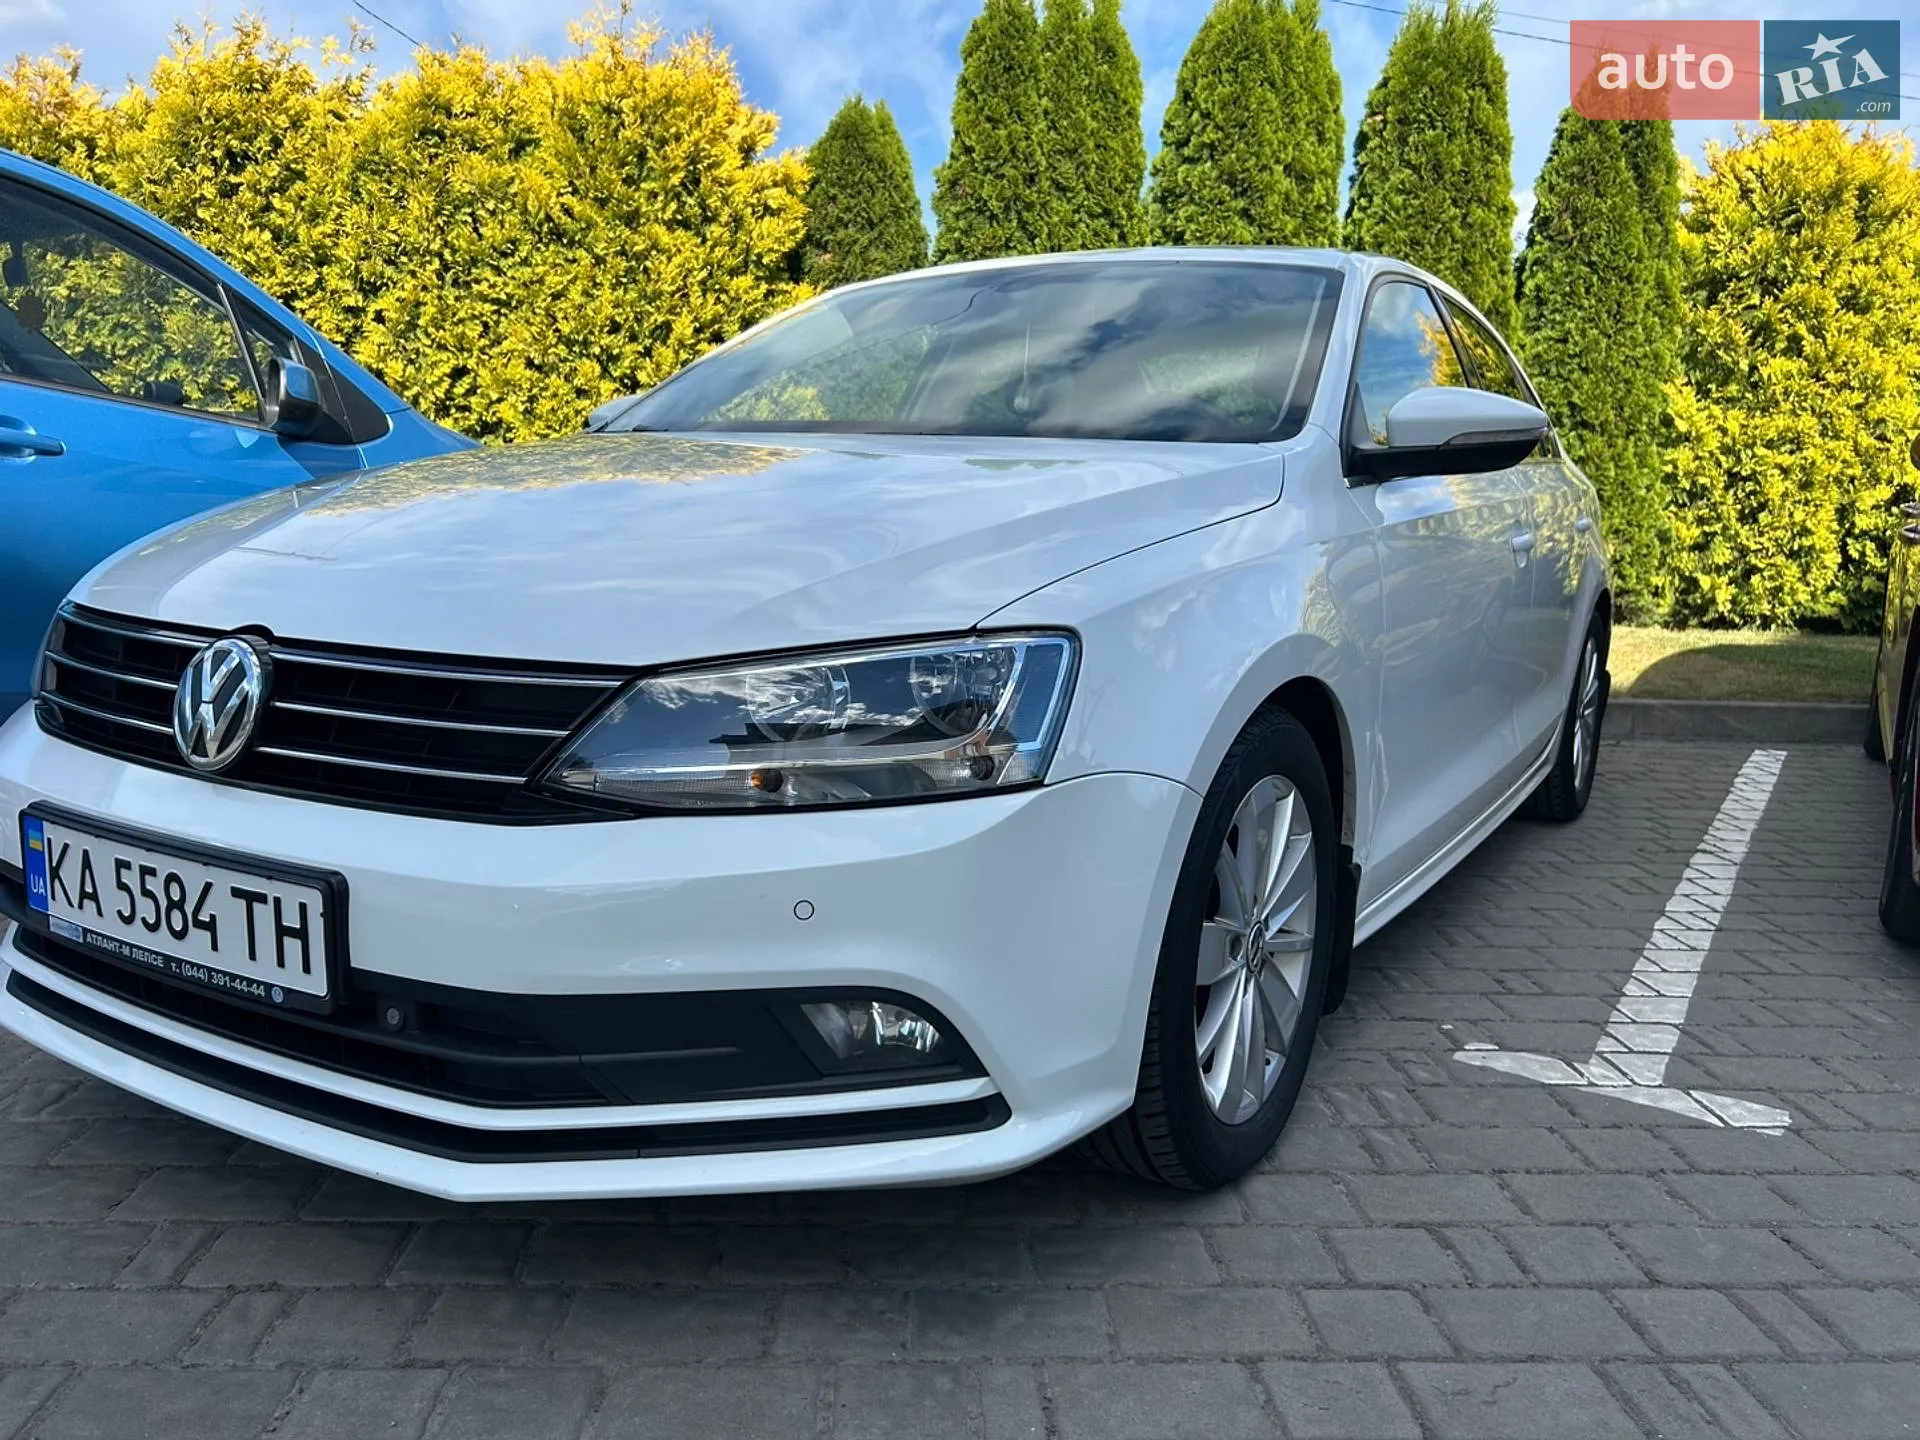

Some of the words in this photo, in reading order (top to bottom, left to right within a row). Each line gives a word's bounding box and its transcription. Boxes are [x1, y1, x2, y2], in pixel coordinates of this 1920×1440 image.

[30, 872, 47, 897] UA
[46, 836, 104, 918] KA
[113, 856, 220, 953] 5584
[230, 885, 312, 975] TH
[181, 961, 208, 982] (044)
[211, 972, 266, 997] 391-44-44
